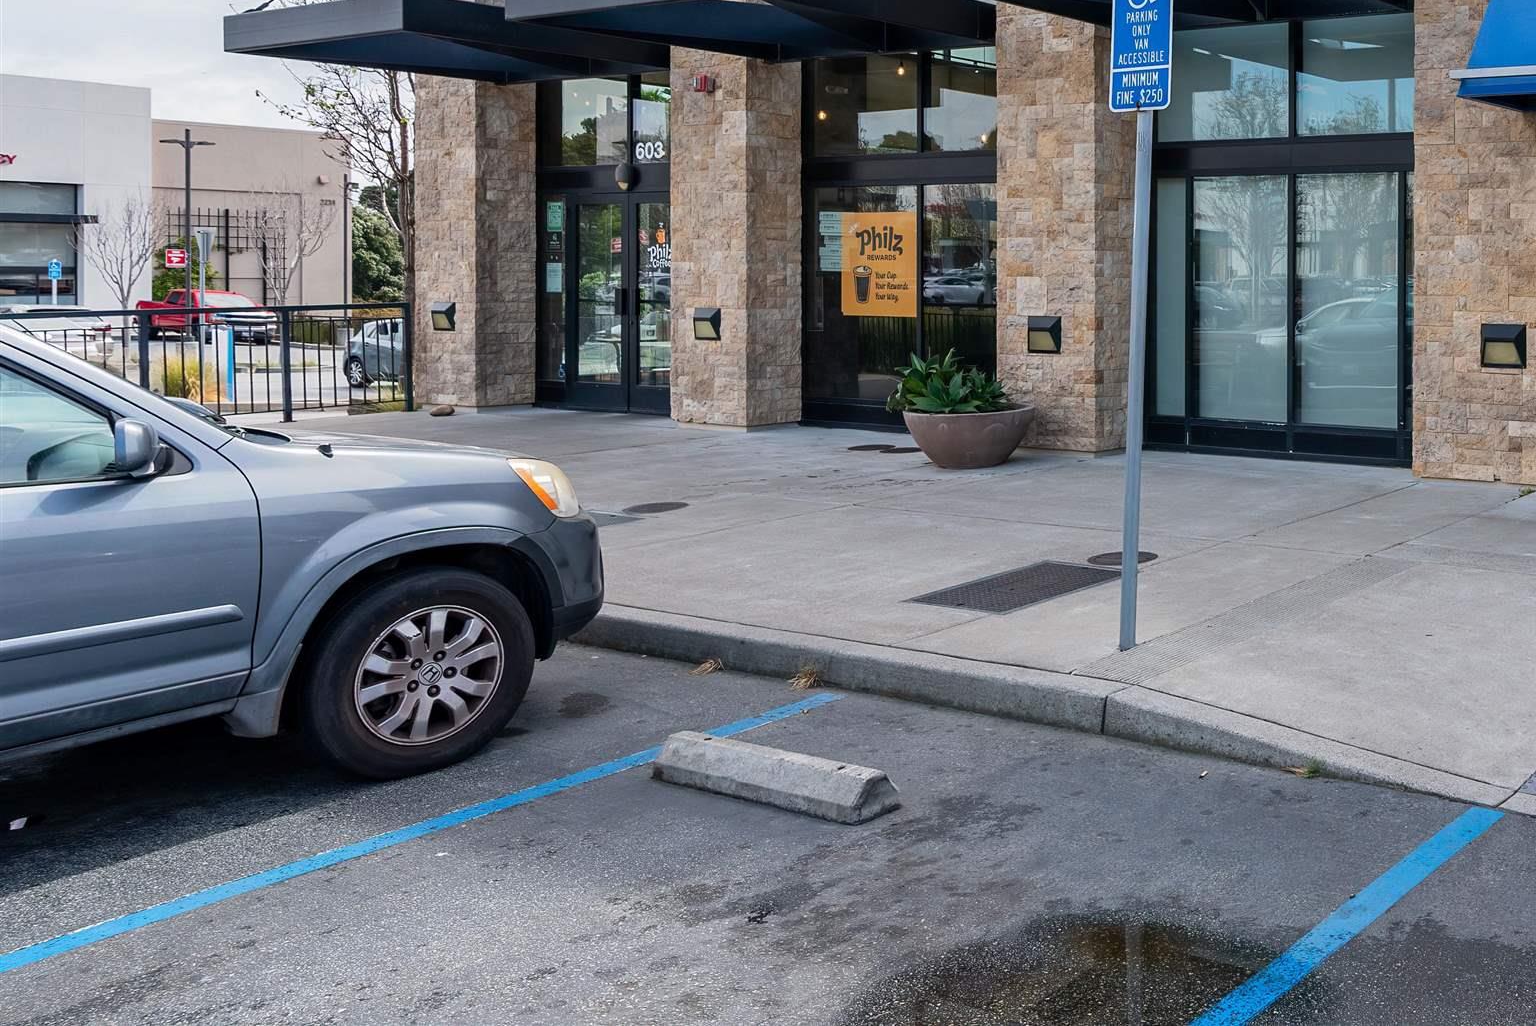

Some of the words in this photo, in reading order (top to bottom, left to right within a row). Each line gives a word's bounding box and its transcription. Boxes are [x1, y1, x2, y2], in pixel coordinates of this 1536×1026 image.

[1126, 9, 1158, 24] PARKING
[1132, 24, 1151, 37] ONLY
[1134, 38, 1149, 50] VAN
[1118, 50, 1165, 65] ACCESSIBLE
[1122, 72, 1159, 88] MINIMUM
[1116, 90, 1134, 105] FINE
[1139, 88, 1163, 104] $250
[635, 141, 664, 160] 603
[856, 225, 903, 256] Philz
[875, 271, 886, 279] Your
[875, 282, 886, 290] Your
[875, 293, 886, 301] Your
